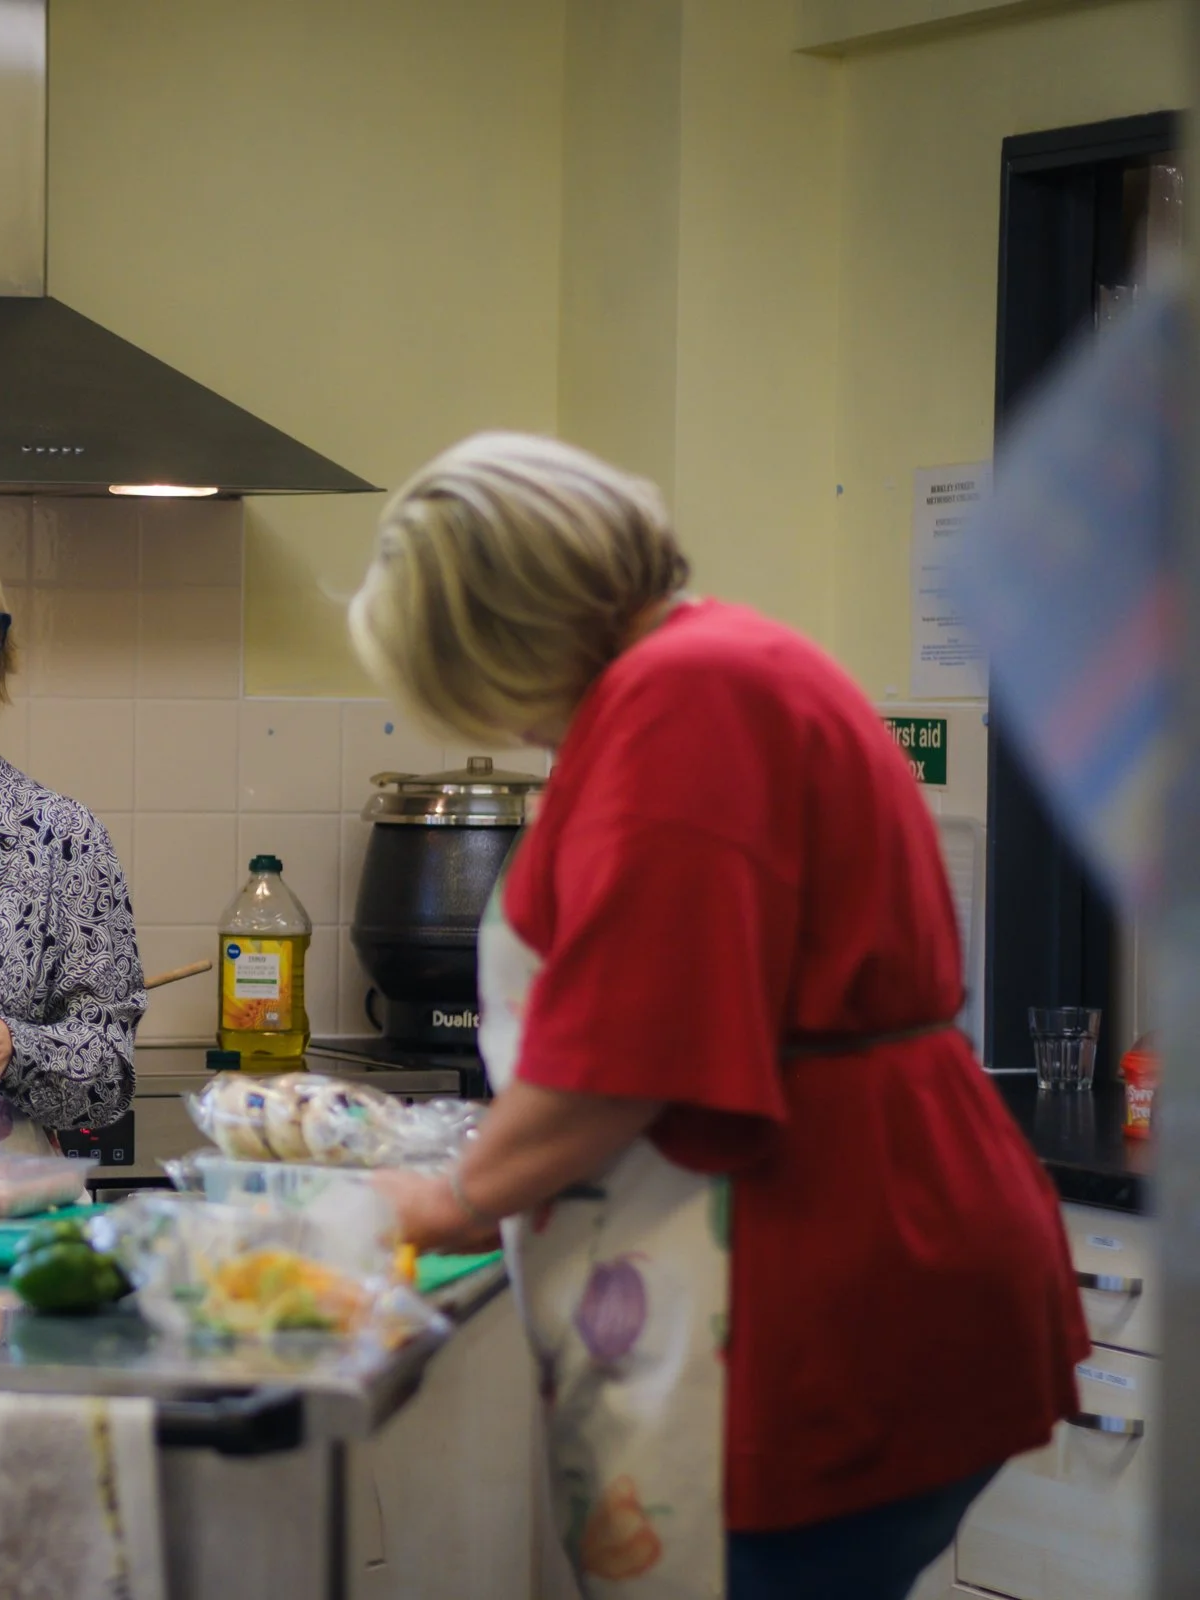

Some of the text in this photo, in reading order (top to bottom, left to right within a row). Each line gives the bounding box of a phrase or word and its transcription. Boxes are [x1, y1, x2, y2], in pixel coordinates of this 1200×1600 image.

[883, 719, 941, 749] First aid
[908, 759, 926, 781] ox
